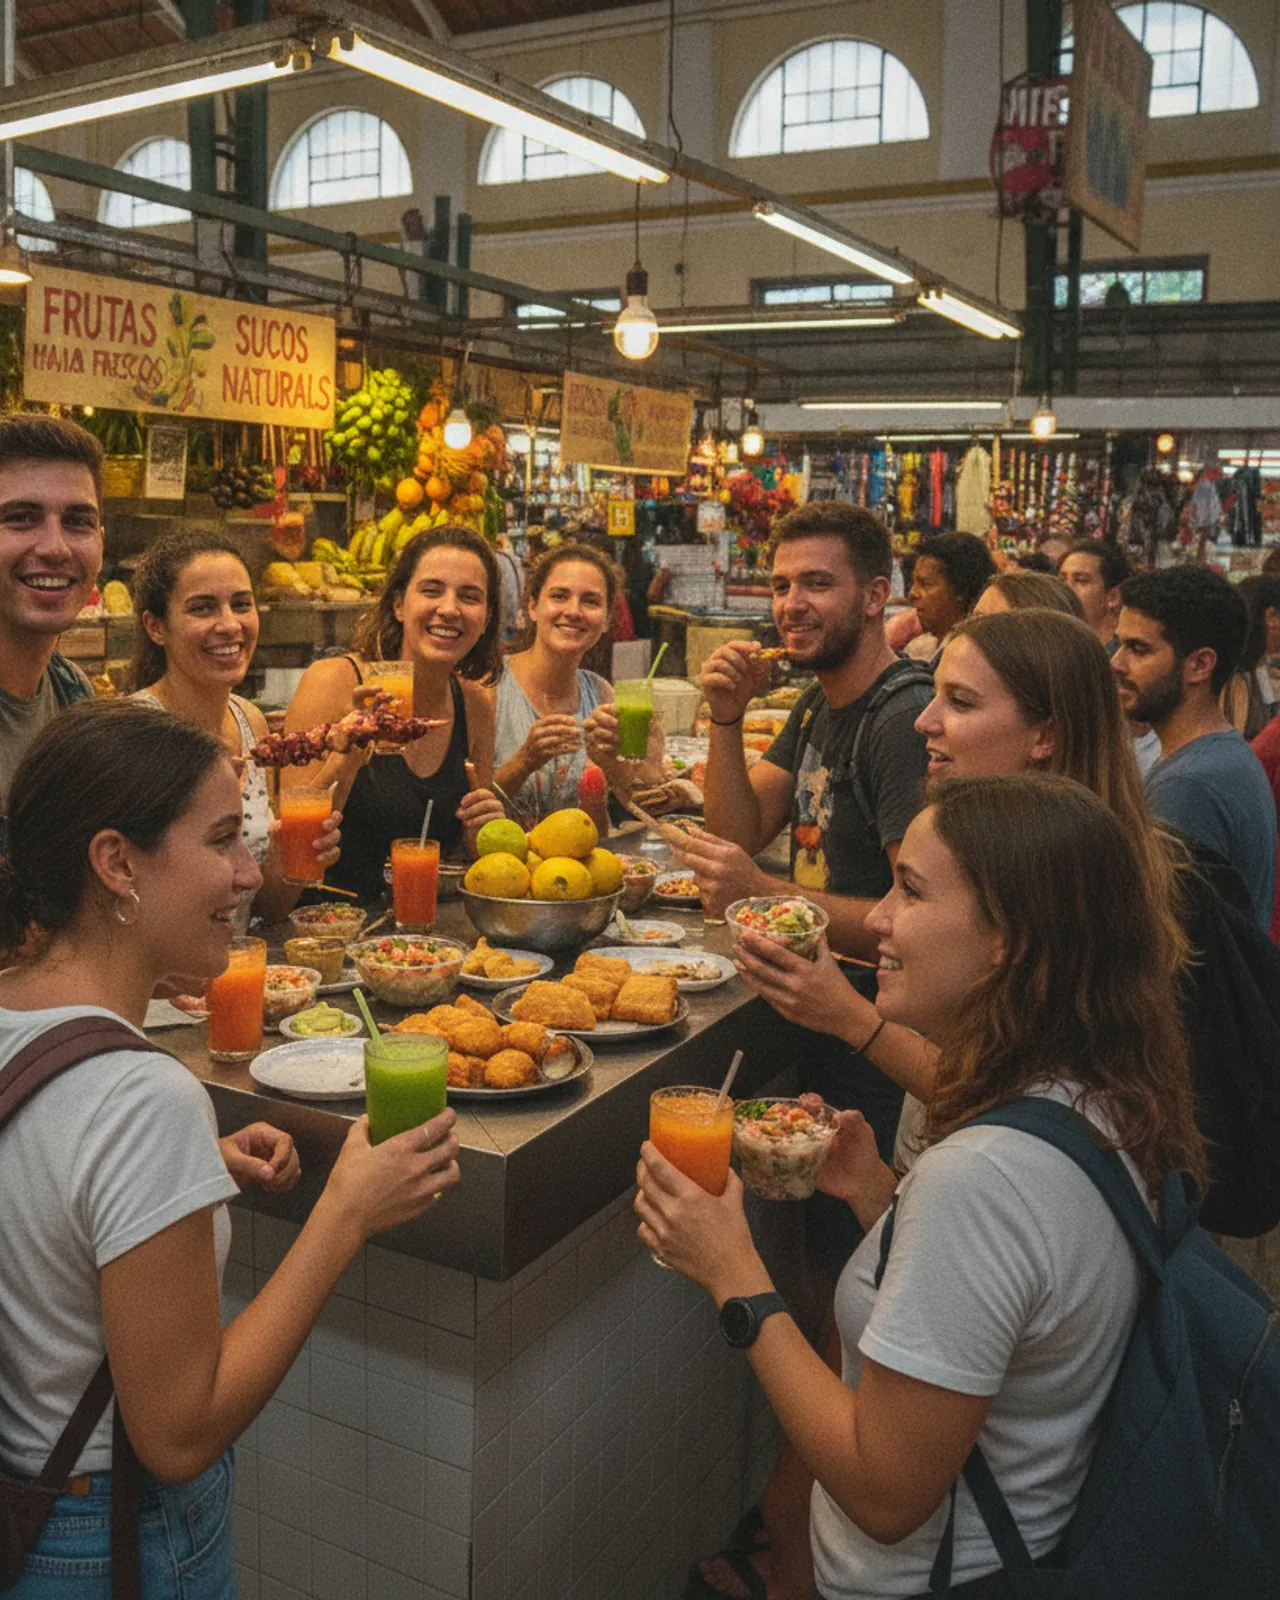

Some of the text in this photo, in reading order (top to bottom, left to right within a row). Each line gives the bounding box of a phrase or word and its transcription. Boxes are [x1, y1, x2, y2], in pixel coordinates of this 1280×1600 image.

[43, 286, 157, 348] FRUTAS
[235, 314, 309, 364] SUCOS
[222, 363, 331, 412] NATURALS
